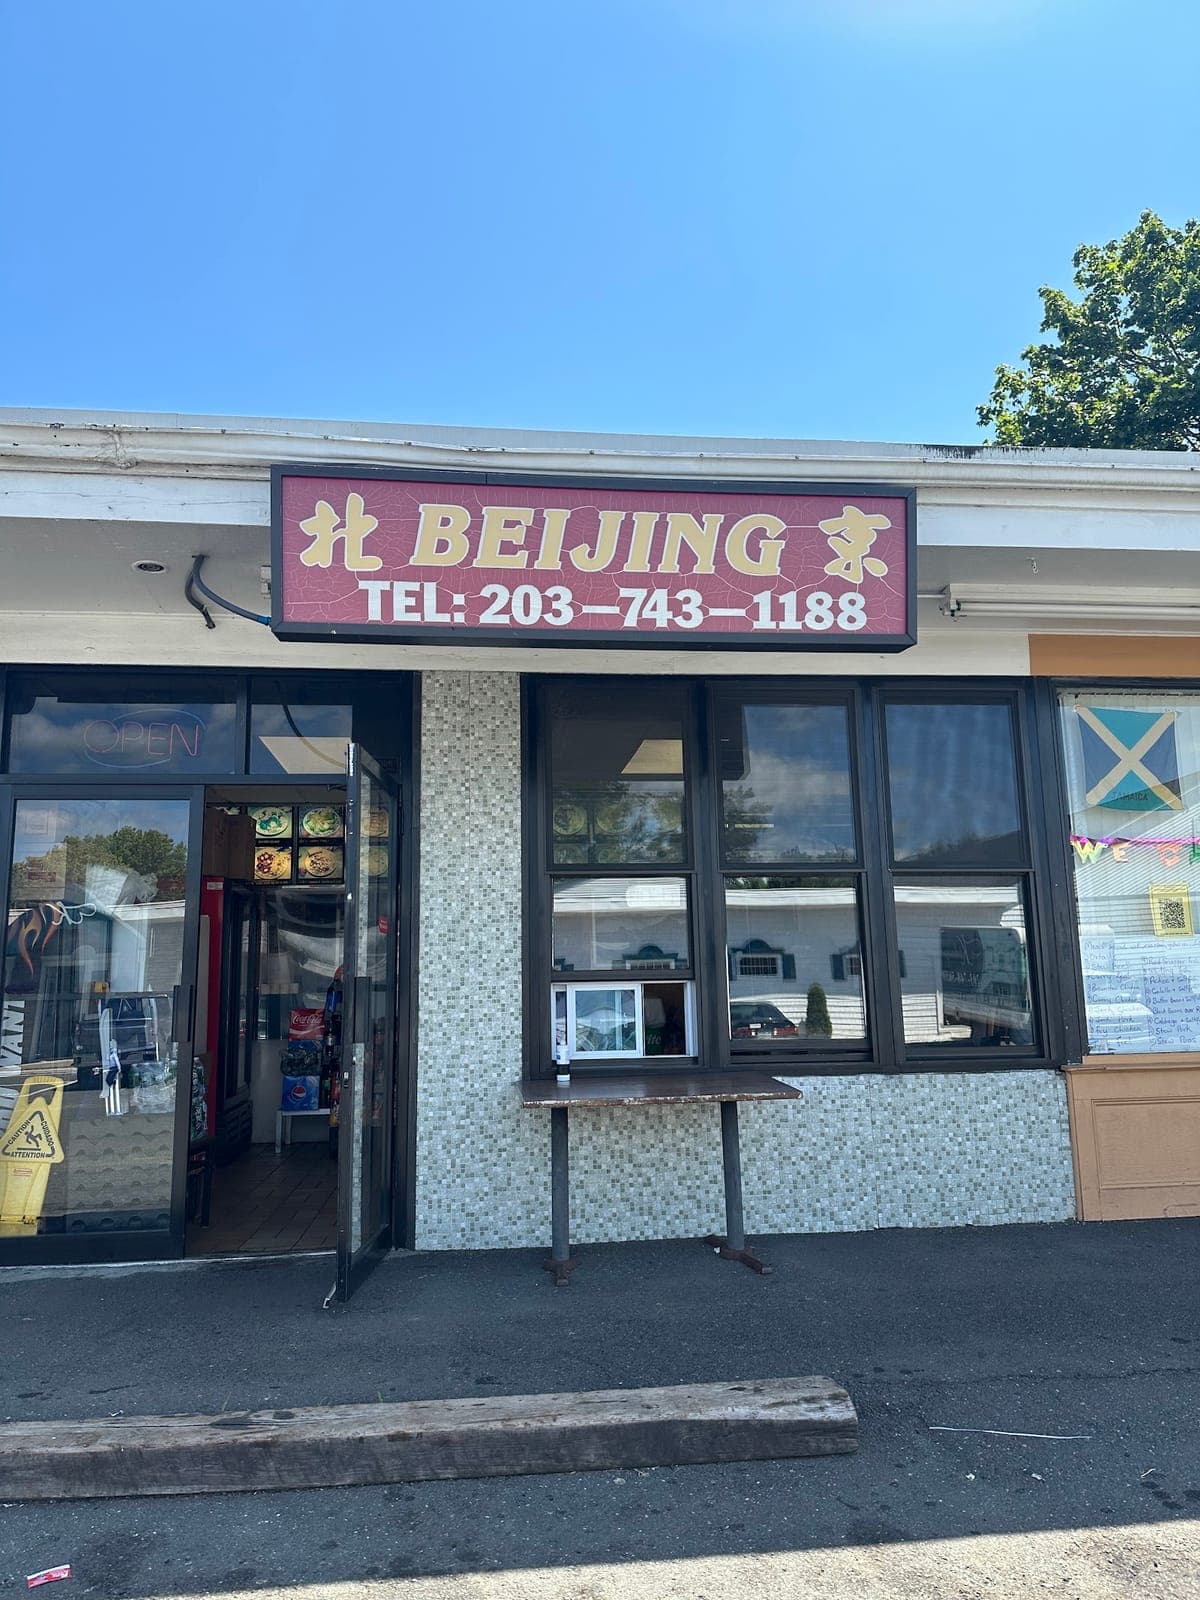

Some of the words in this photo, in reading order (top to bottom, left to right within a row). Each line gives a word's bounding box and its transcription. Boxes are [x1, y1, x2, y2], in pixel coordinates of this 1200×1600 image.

[299, 492, 383, 572] 北
[408, 502, 787, 577] BEIJING
[818, 505, 892, 584] 京
[358, 580, 466, 624] TEL:
[83, 719, 199, 757] OPEN
[8, 1119, 31, 1145] CAUTION
[10, 1151, 46, 1159] ATTENTION
